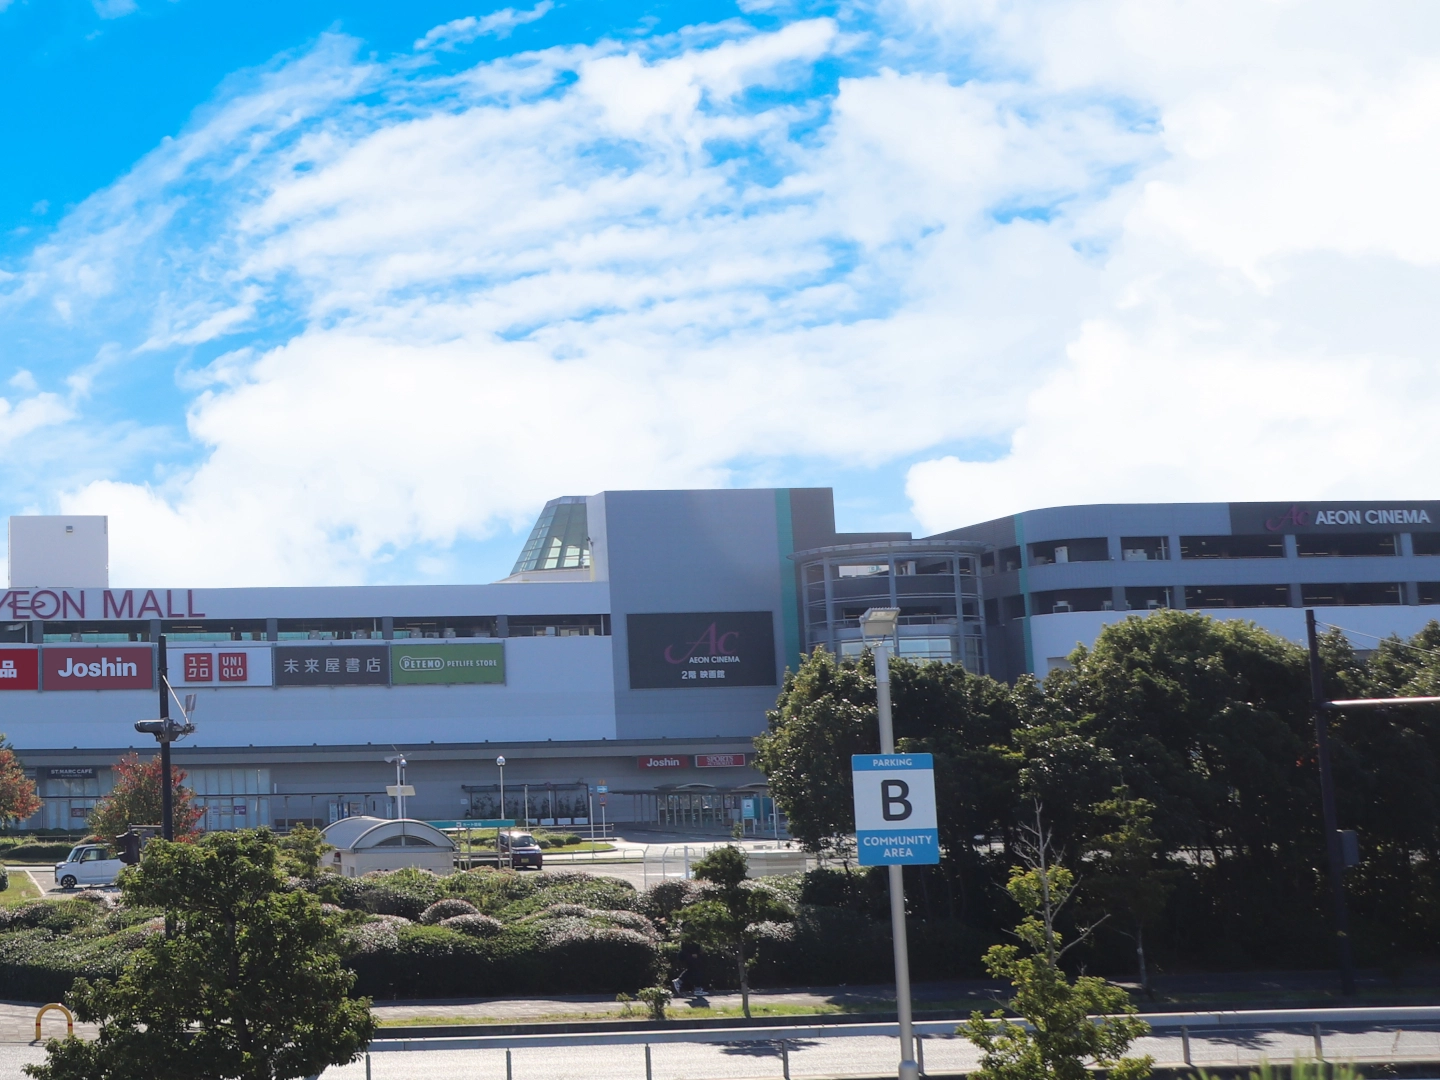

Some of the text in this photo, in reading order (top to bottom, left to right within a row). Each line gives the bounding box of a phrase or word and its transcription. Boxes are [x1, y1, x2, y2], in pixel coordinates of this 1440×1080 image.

[1315, 510, 1361, 525] AEON
[1365, 509, 1431, 524] CINEMA
[102, 589, 206, 618] MALL
[222, 657, 242, 666] UNI
[688, 656, 710, 664] AEON
[58, 657, 137, 677] Joshin
[284, 658, 381, 674] 未来屋書店
[222, 668, 244, 678] QLO
[681, 670, 725, 679] 2階 映画館
[646, 757, 680, 767] Joshin
[872, 758, 913, 767] PARKING
[881, 779, 913, 821] B
[863, 835, 932, 846] COMMUNITY
[883, 848, 913, 858] AREA
